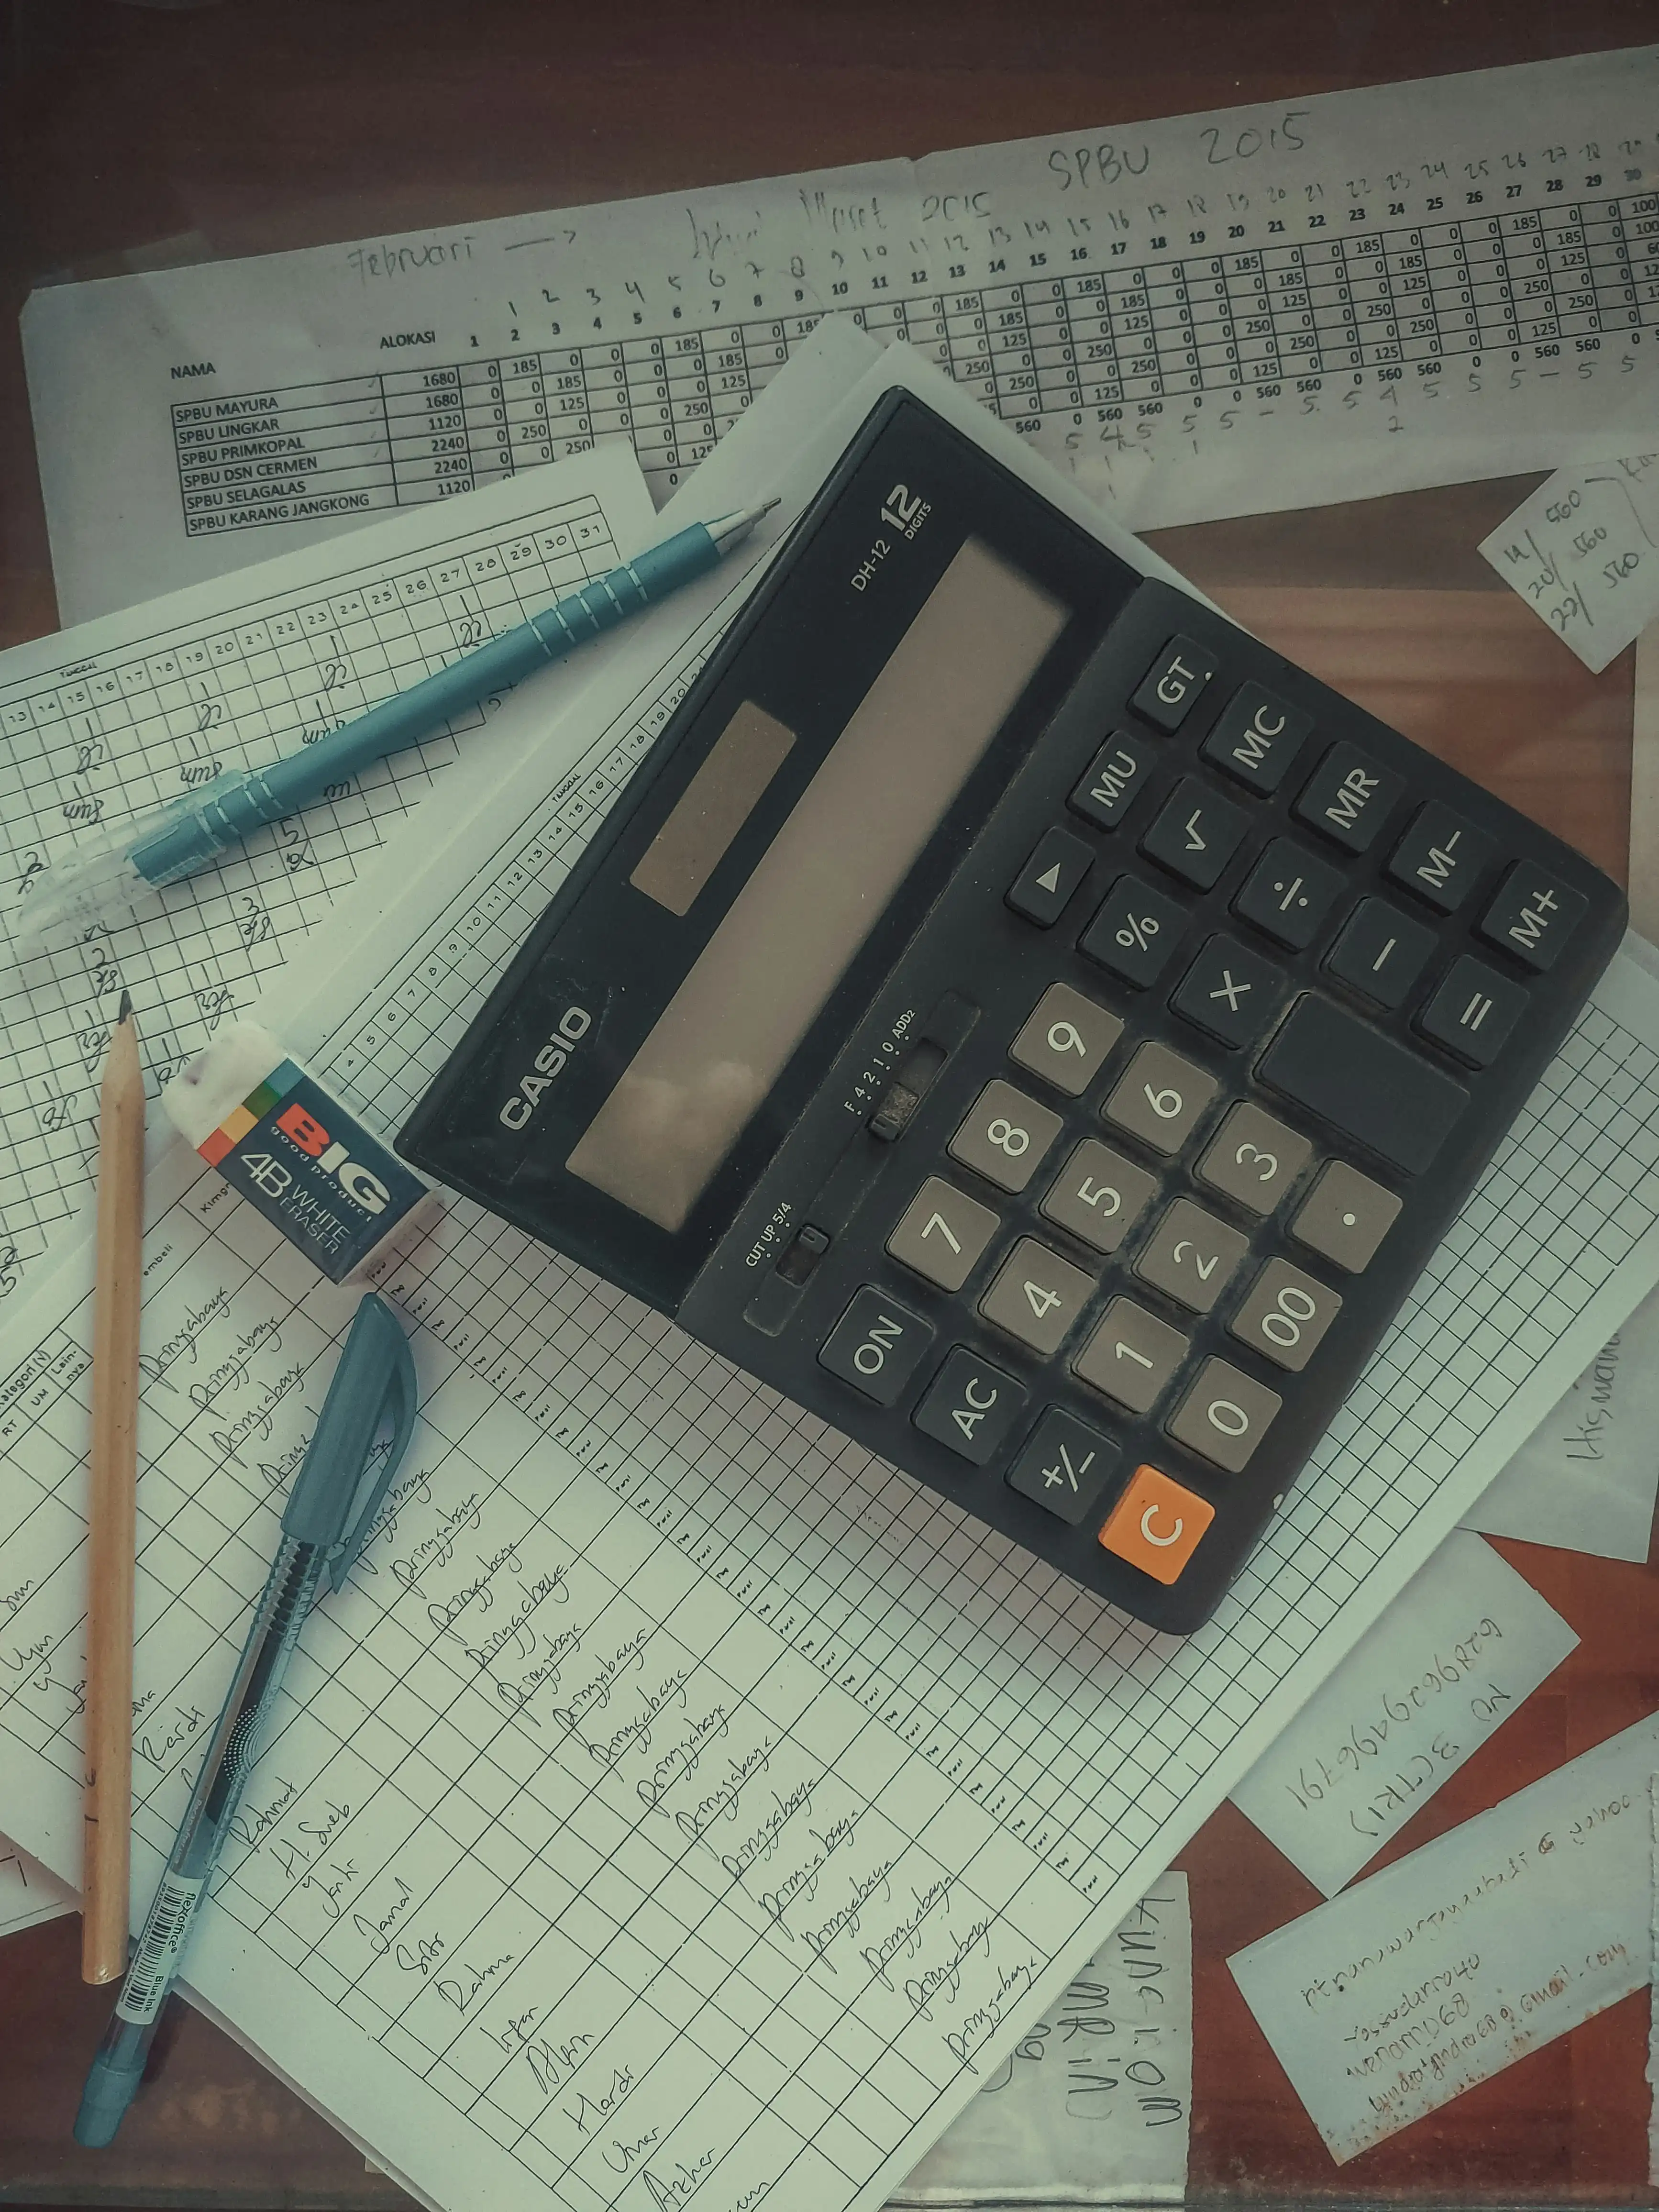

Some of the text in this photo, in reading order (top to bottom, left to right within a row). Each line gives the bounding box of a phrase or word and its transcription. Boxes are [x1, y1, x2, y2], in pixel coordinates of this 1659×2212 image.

[1049, 143, 1148, 191] SPBU
[380, 174, 1602, 349] ALOKASI 1 2 3 5 7 9 10 11 12 13 14 15 16 17 18 19 20 21 22 23 24 25 26 27 28 29
[176, 199, 1656, 423] SPBU MAYURA 1680 185 185 185 100
[178, 231, 1582, 444] SPBU LINGKAR 1680 185 185
[170, 363, 216, 379] NAMA
[181, 316, 1149, 466] SPBU PRIMKOPAL 1120 125
[184, 279, 1549, 487] SPBU DSN CERMEN 2240 250 250
[1016, 362, 1442, 434] 560 560 560
[189, 345, 1399, 531] SPBU KARANG JANGKONG 1120 125
[187, 458, 467, 509] SPBU SELAGALAS 2240
[881, 484, 922, 531] 12
[904, 501, 931, 540] DIGITS
[215, 642, 234, 654] 20
[276, 622, 296, 635] 22
[308, 612, 327, 625] 23
[372, 591, 392, 604] 25
[406, 580, 427, 593] 26
[440, 569, 461, 583] 27
[476, 558, 497, 572] 28
[510, 547, 531, 561] 29
[545, 536, 567, 549] 30
[580, 525, 600, 539] 31
[851, 540, 890, 591] DH-12
[1156, 656, 1197, 705] GT
[1232, 704, 1287, 770] MC
[1090, 750, 1139, 808] MU
[1325, 767, 1381, 830] MR
[467, 711, 665, 931] 10 13 15 16 18 19
[1114, 912, 1160, 951] %
[1508, 888, 1559, 950] M+
[1046, 1020, 1087, 1059] 9
[500, 1006, 592, 1130] CASIO
[844, 1101, 854, 1113] F
[854, 1086, 865, 1098] 4
[863, 1072, 876, 1084] 2
[873, 1057, 885, 1067] 1
[882, 1042, 894, 1053] 0
[1143, 1082, 1184, 1119] 6
[276, 1103, 390, 1215] BIG
[987, 1117, 1030, 1157] 8
[1235, 1141, 1278, 1181] 3
[241, 1153, 293, 1198] 4B
[271, 1127, 371, 1222] good product
[1077, 1175, 1123, 1217] 5
[279, 1197, 340, 1255] ERASER
[291, 1184, 350, 1239] WHITE
[745, 1201, 792, 1267] CUT UP 5/4
[920, 1212, 962, 1255] 7
[1172, 1240, 1220, 1282] 2
[1022, 1278, 1062, 1320] 4
[1261, 1286, 1316, 1349] 00
[853, 1314, 905, 1375] ON
[1115, 1340, 1154, 1370] 1
[32, 1389, 49, 1407] UM
[950, 1377, 998, 1440] AC
[1206, 1399, 1249, 1437] 0
[1041, 1443, 1095, 1492] +/-
[1141, 1504, 1183, 1548] C
[143, 1975, 164, 2013] Blue Ink
